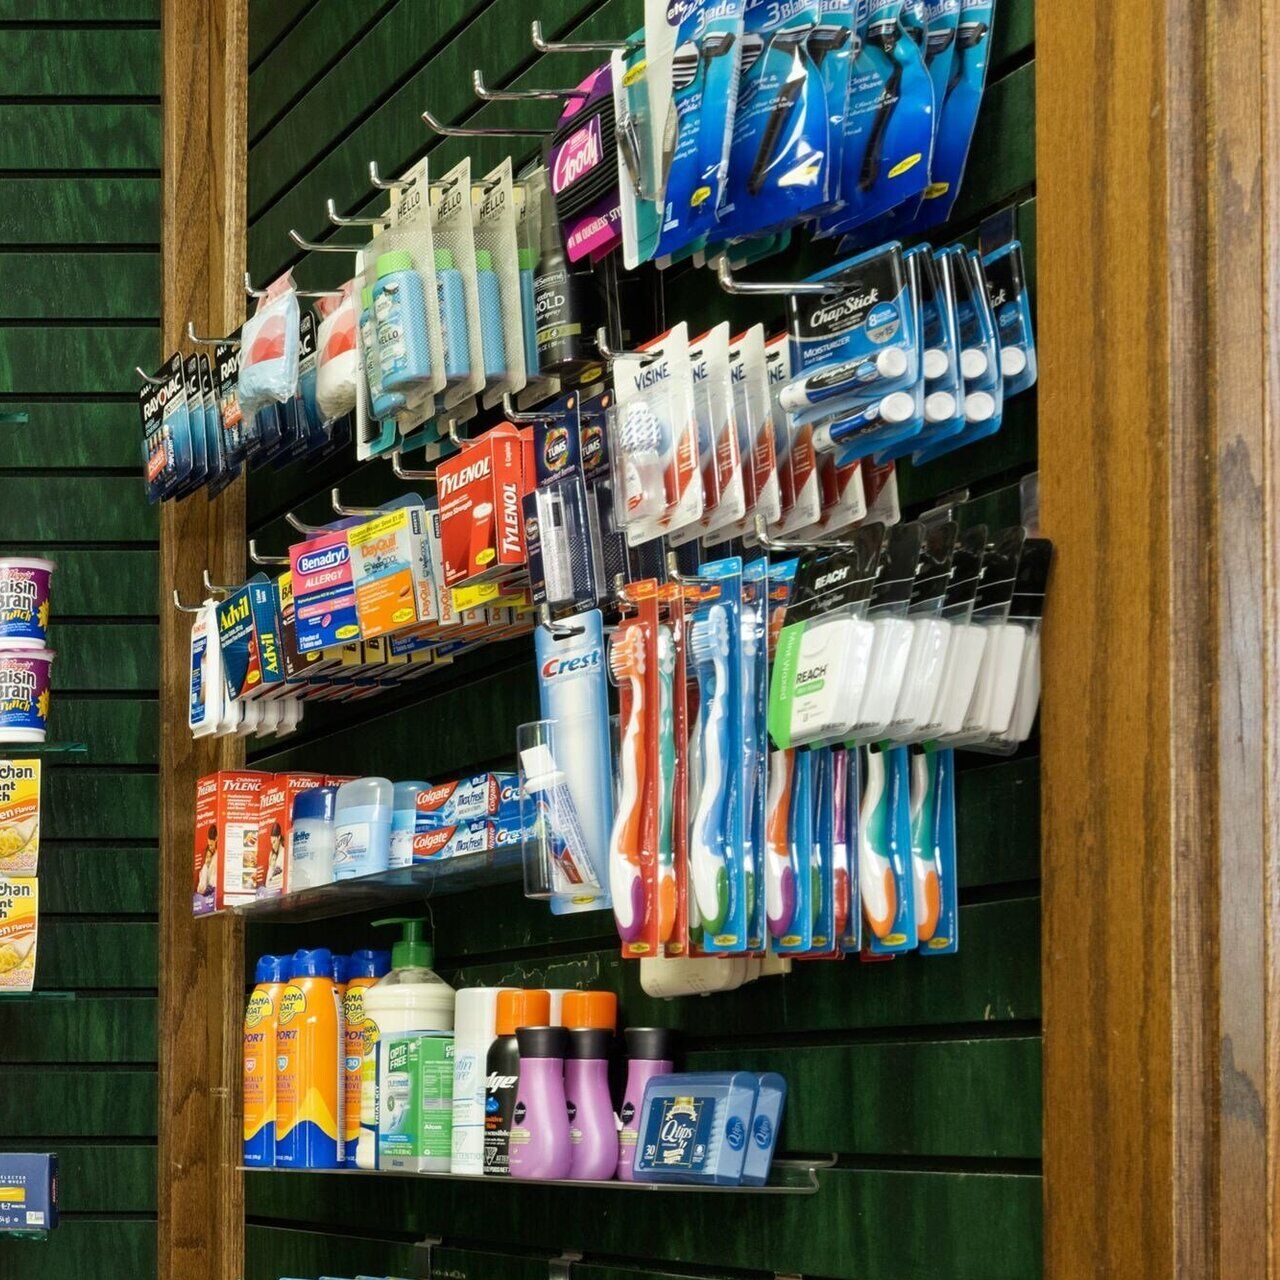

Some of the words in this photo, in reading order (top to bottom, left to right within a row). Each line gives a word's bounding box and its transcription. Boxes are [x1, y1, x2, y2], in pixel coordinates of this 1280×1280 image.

[810, 289, 879, 326] ChapStick
[634, 366, 670, 390] VISINE
[144, 376, 183, 418] RAYOVAC
[439, 456, 491, 491] TYLENOL
[501, 482, 518, 553] TYLENOL
[301, 547, 347, 573] Benadryl
[305, 571, 344, 588] ALLERGY
[815, 567, 847, 588] REACH
[218, 597, 250, 632] Advil
[541, 649, 600, 678] Crest
[796, 665, 827, 684] REACH
[416, 783, 455, 809] Colgate
[15, 806, 35, 814] Flavor
[389, 1056, 407, 1071] FREE
